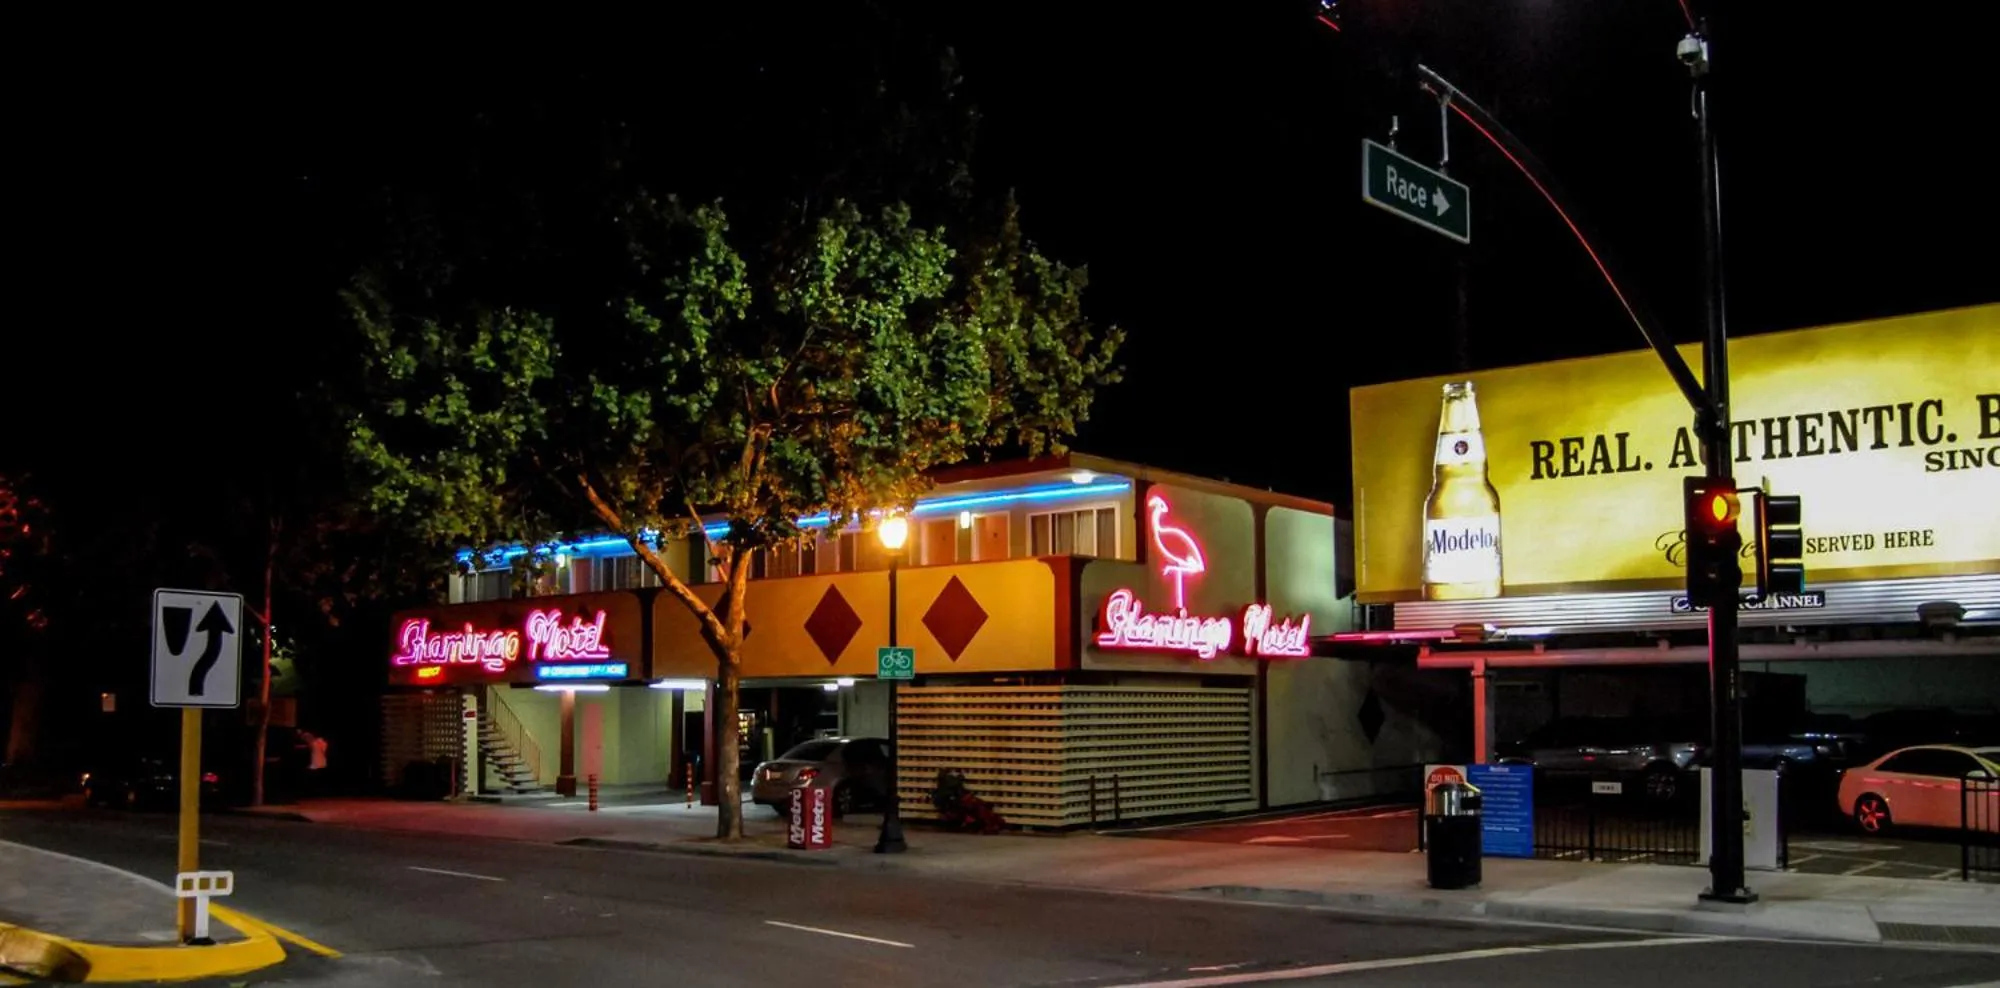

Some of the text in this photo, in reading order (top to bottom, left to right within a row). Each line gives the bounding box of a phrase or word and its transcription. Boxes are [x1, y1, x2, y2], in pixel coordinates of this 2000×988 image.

[1386, 164, 1428, 209] Race
[1529, 431, 1653, 480] REAL.
[1668, 397, 1957, 468] ATHENTIC.
[1432, 526, 1493, 555] Modelo
[1805, 529, 1934, 554] SERVED HERE
[392, 608, 610, 672] Flamingo Motel
[1097, 588, 1311, 660] Flamingo Motel
[790, 788, 805, 844] Metro
[811, 788, 825, 844] Metro
